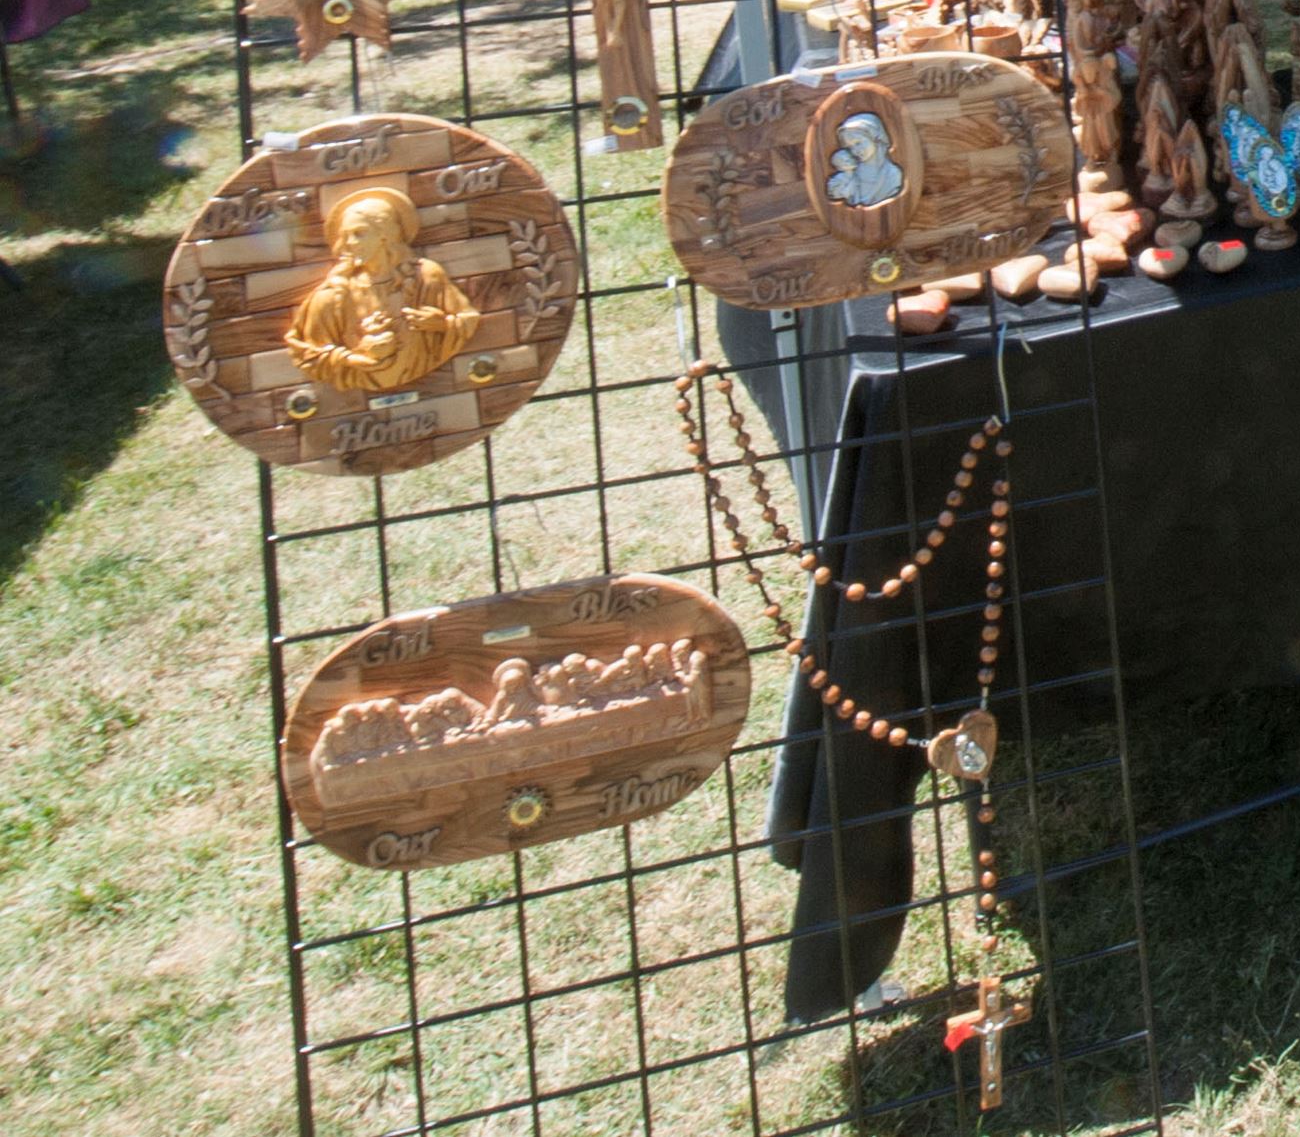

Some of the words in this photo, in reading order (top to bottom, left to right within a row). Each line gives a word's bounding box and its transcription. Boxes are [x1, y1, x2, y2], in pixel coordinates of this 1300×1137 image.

[723, 82, 789, 130] God
[917, 60, 997, 93] Bless
[320, 123, 398, 174] God
[203, 187, 309, 233] Bless
[435, 160, 506, 196] Our
[751, 270, 814, 305] Our
[330, 407, 438, 455] Home
[357, 614, 434, 667] God
[569, 584, 660, 623] Bless
[366, 826, 441, 864] Our
[601, 768, 698, 818] Home
